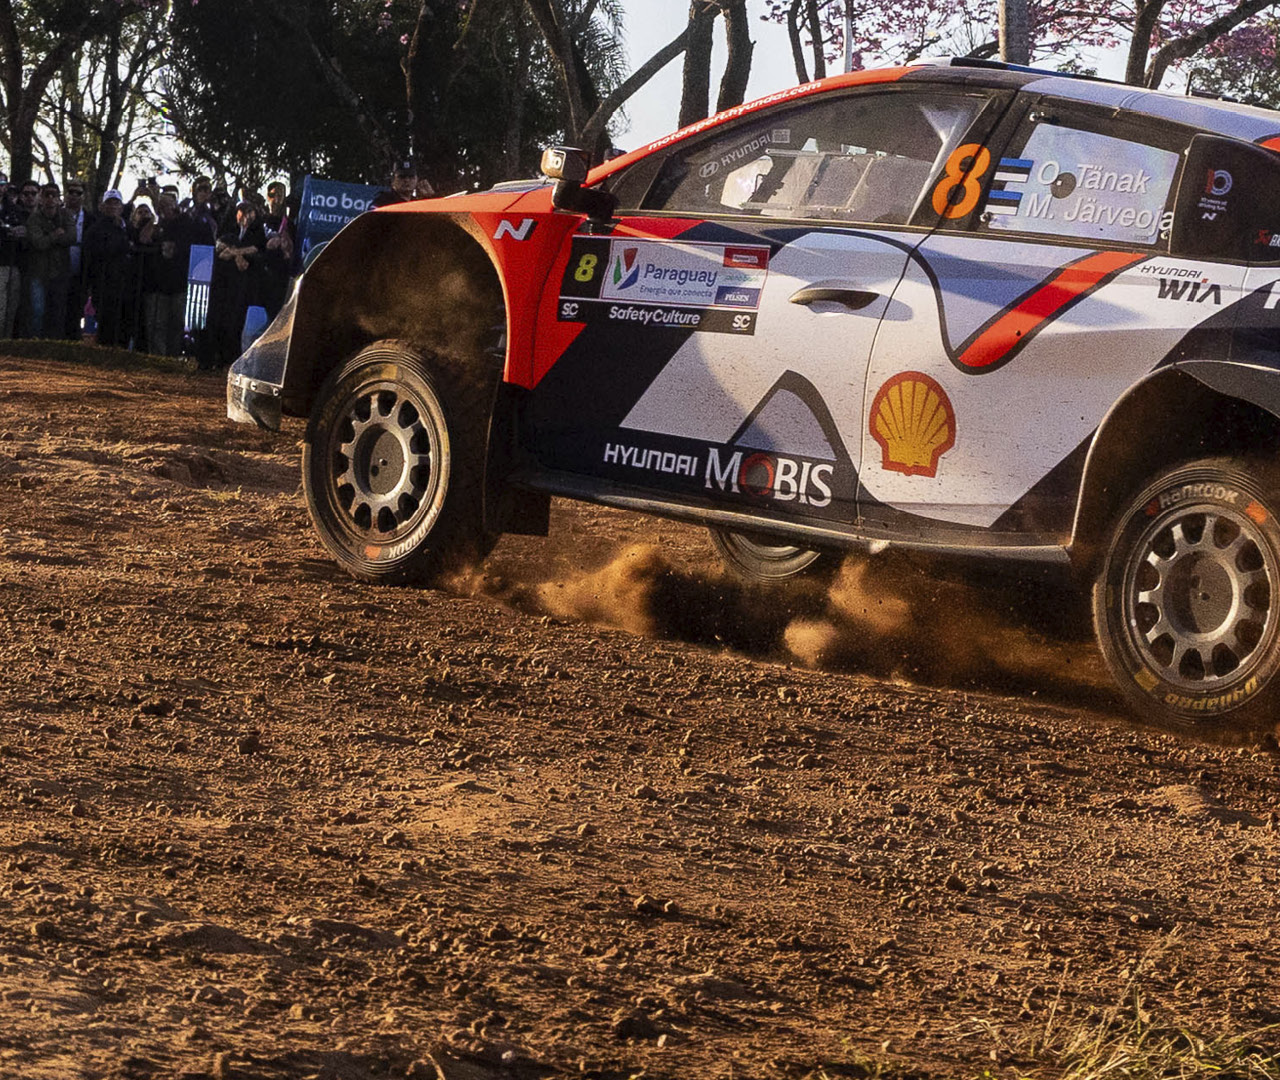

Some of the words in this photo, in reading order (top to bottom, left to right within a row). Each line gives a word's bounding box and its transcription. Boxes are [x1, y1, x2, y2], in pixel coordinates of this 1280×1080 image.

[648, 82, 821, 150] motorsport.hyundai.com
[720, 133, 772, 167] HYUNDAI
[932, 143, 991, 219] 8
[1037, 161, 1062, 186] O.
[1075, 163, 1152, 194] Tänak
[1025, 193, 1055, 219] M.
[1064, 198, 1174, 236] Järveoja
[574, 254, 598, 282] 8
[644, 264, 718, 286] Paraguay
[1141, 264, 1203, 278] HYUNDAI
[1157, 277, 1221, 305] WIA
[561, 302, 579, 316] SC
[609, 305, 700, 325] SafetyCulture
[732, 314, 751, 329] SC
[603, 442, 698, 476] HYUNDAI
[705, 447, 833, 507] MOBIS
